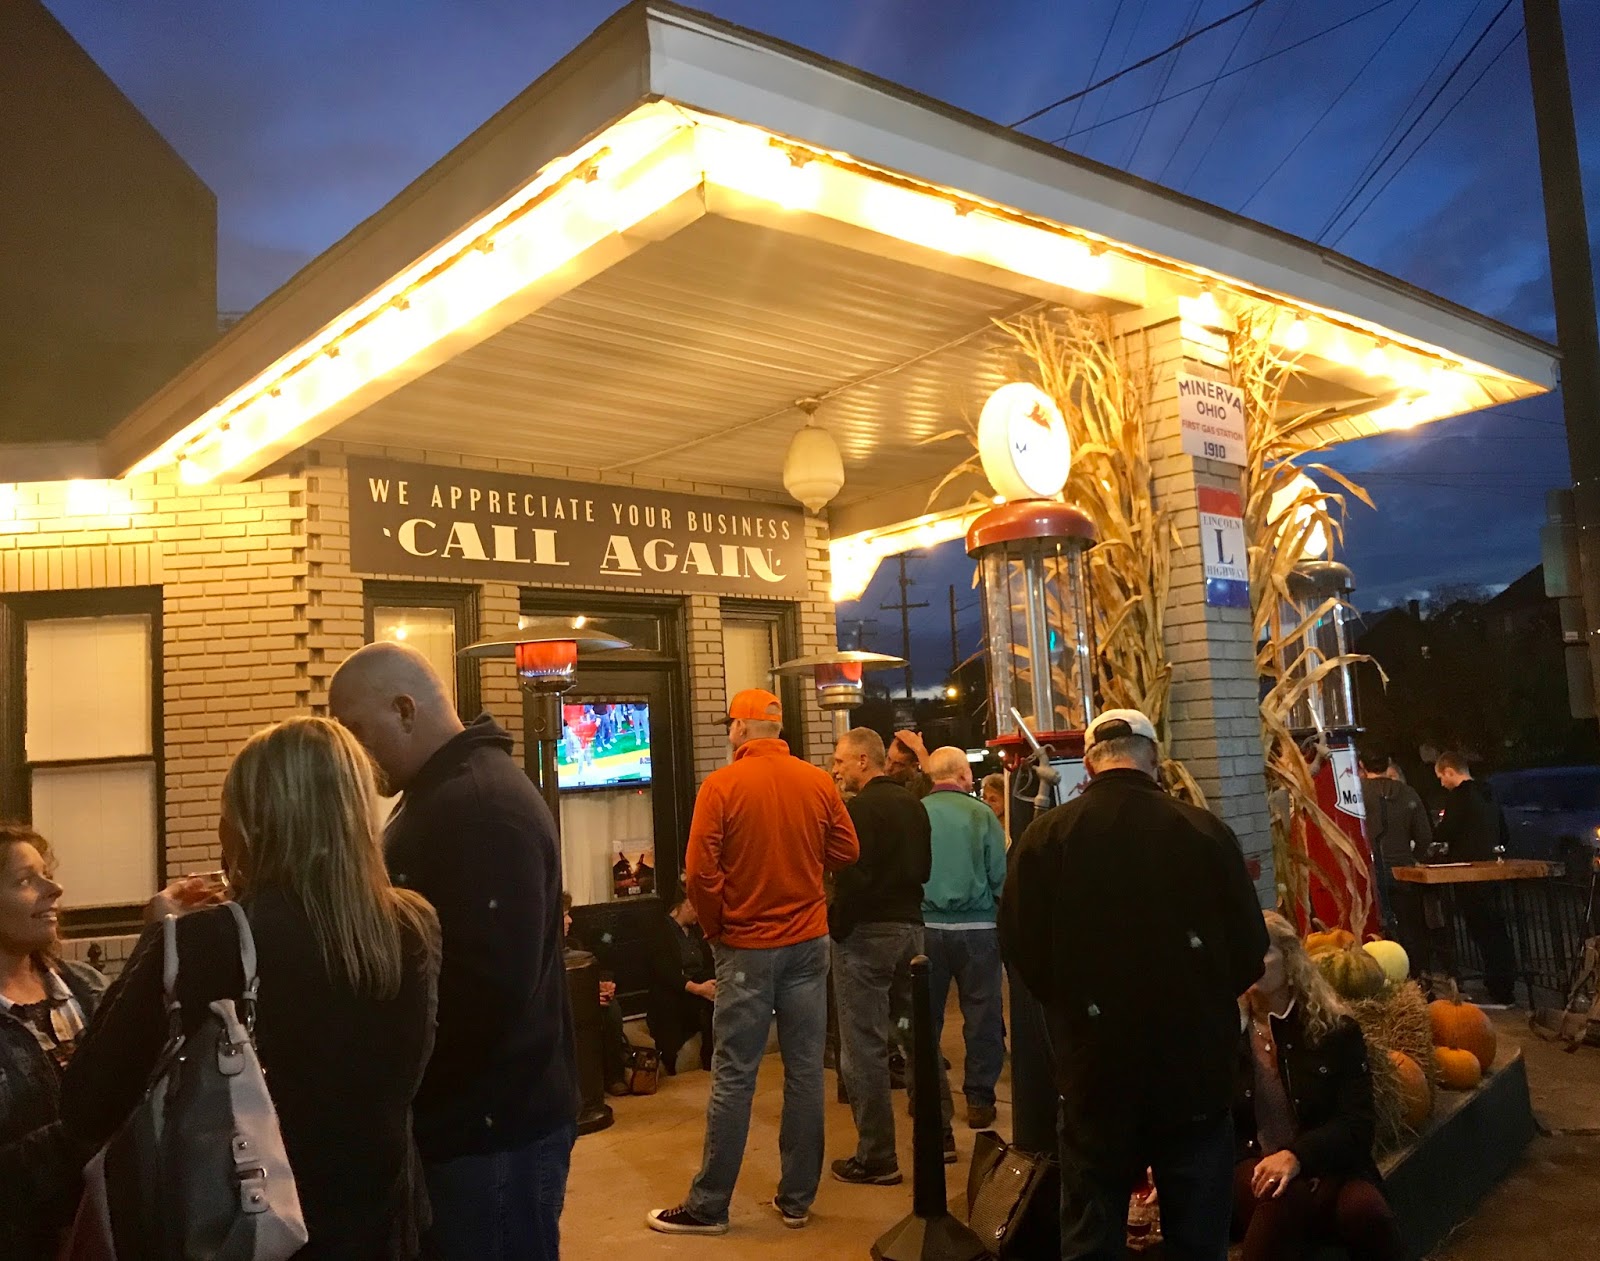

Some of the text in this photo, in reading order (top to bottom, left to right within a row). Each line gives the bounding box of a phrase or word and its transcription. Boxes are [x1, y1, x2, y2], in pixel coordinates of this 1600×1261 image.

[1179, 380, 1242, 414] MINERVA
[1196, 400, 1227, 420] OHIO
[1182, 419, 1244, 441] FIRST GAS STATION
[1203, 441, 1226, 459] 1910
[369, 478, 790, 540] WE APPRECIATE YOUR BUSINESS
[1203, 515, 1240, 529] LINCOLN
[398, 518, 787, 582] CALL AGAIN
[1214, 529, 1234, 565] L
[1206, 565, 1245, 578] HIGHWAY
